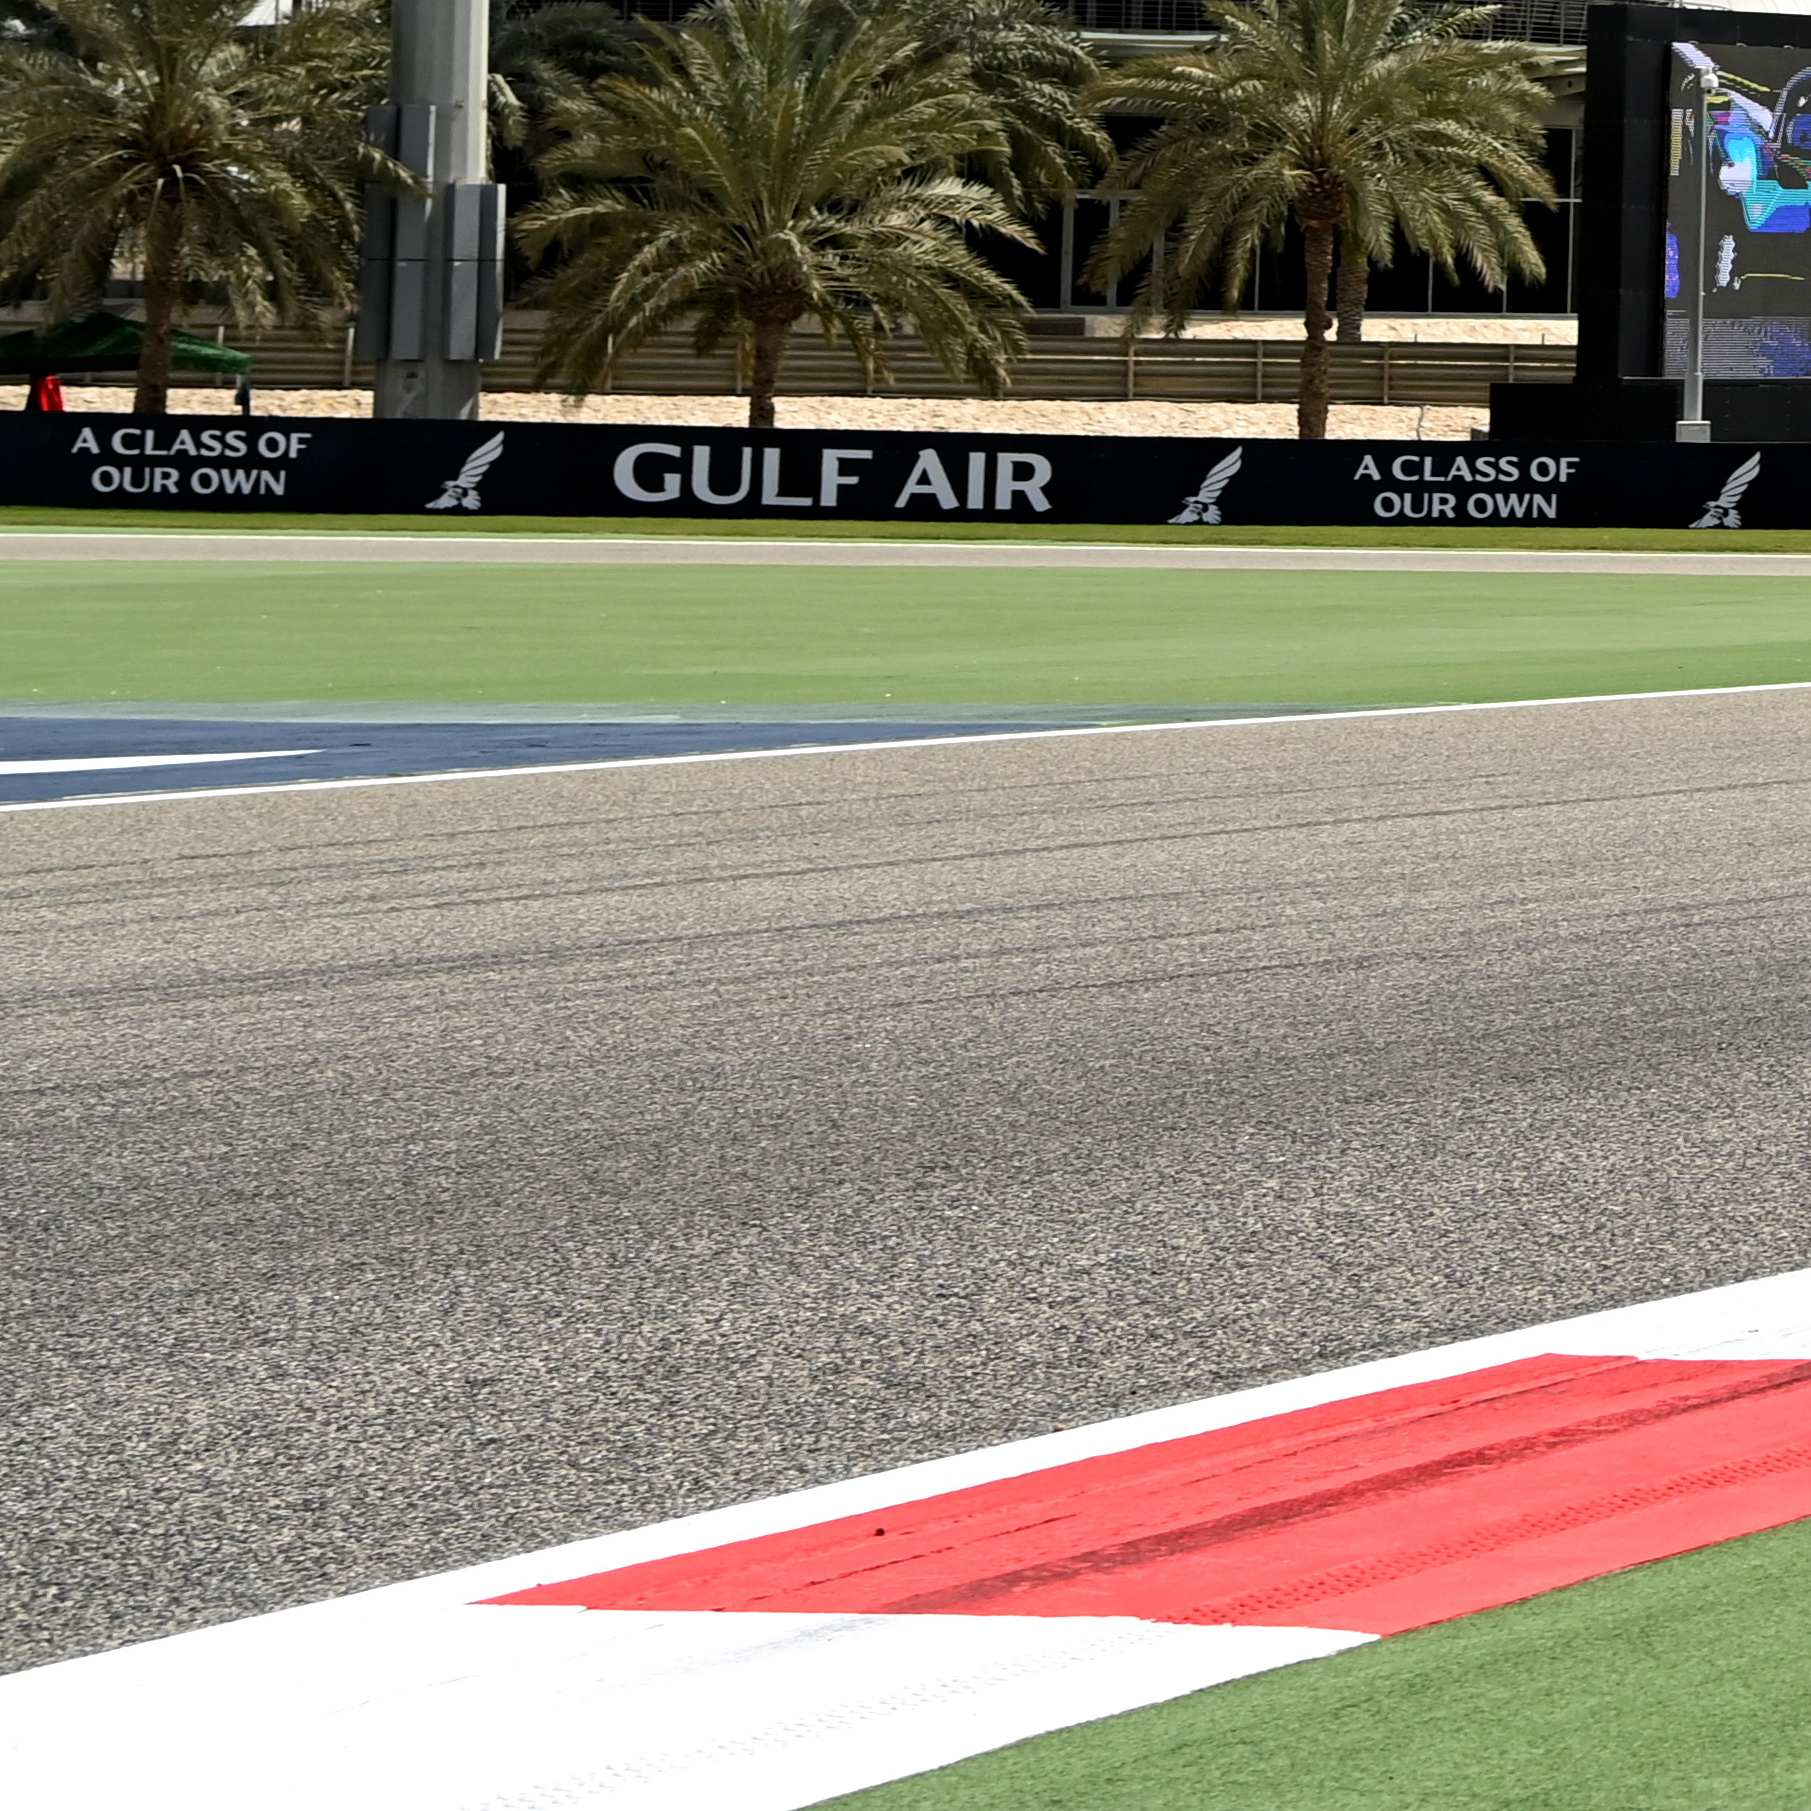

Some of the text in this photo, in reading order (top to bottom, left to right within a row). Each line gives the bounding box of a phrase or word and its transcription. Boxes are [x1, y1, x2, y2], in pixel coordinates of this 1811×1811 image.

[73, 428, 310, 457] A CLASS OF
[93, 467, 284, 494] OUR OWN
[615, 443, 1052, 511] GULF AIR
[1355, 455, 1579, 482] A CLASS OF
[1375, 492, 1556, 518] OUR OWN
